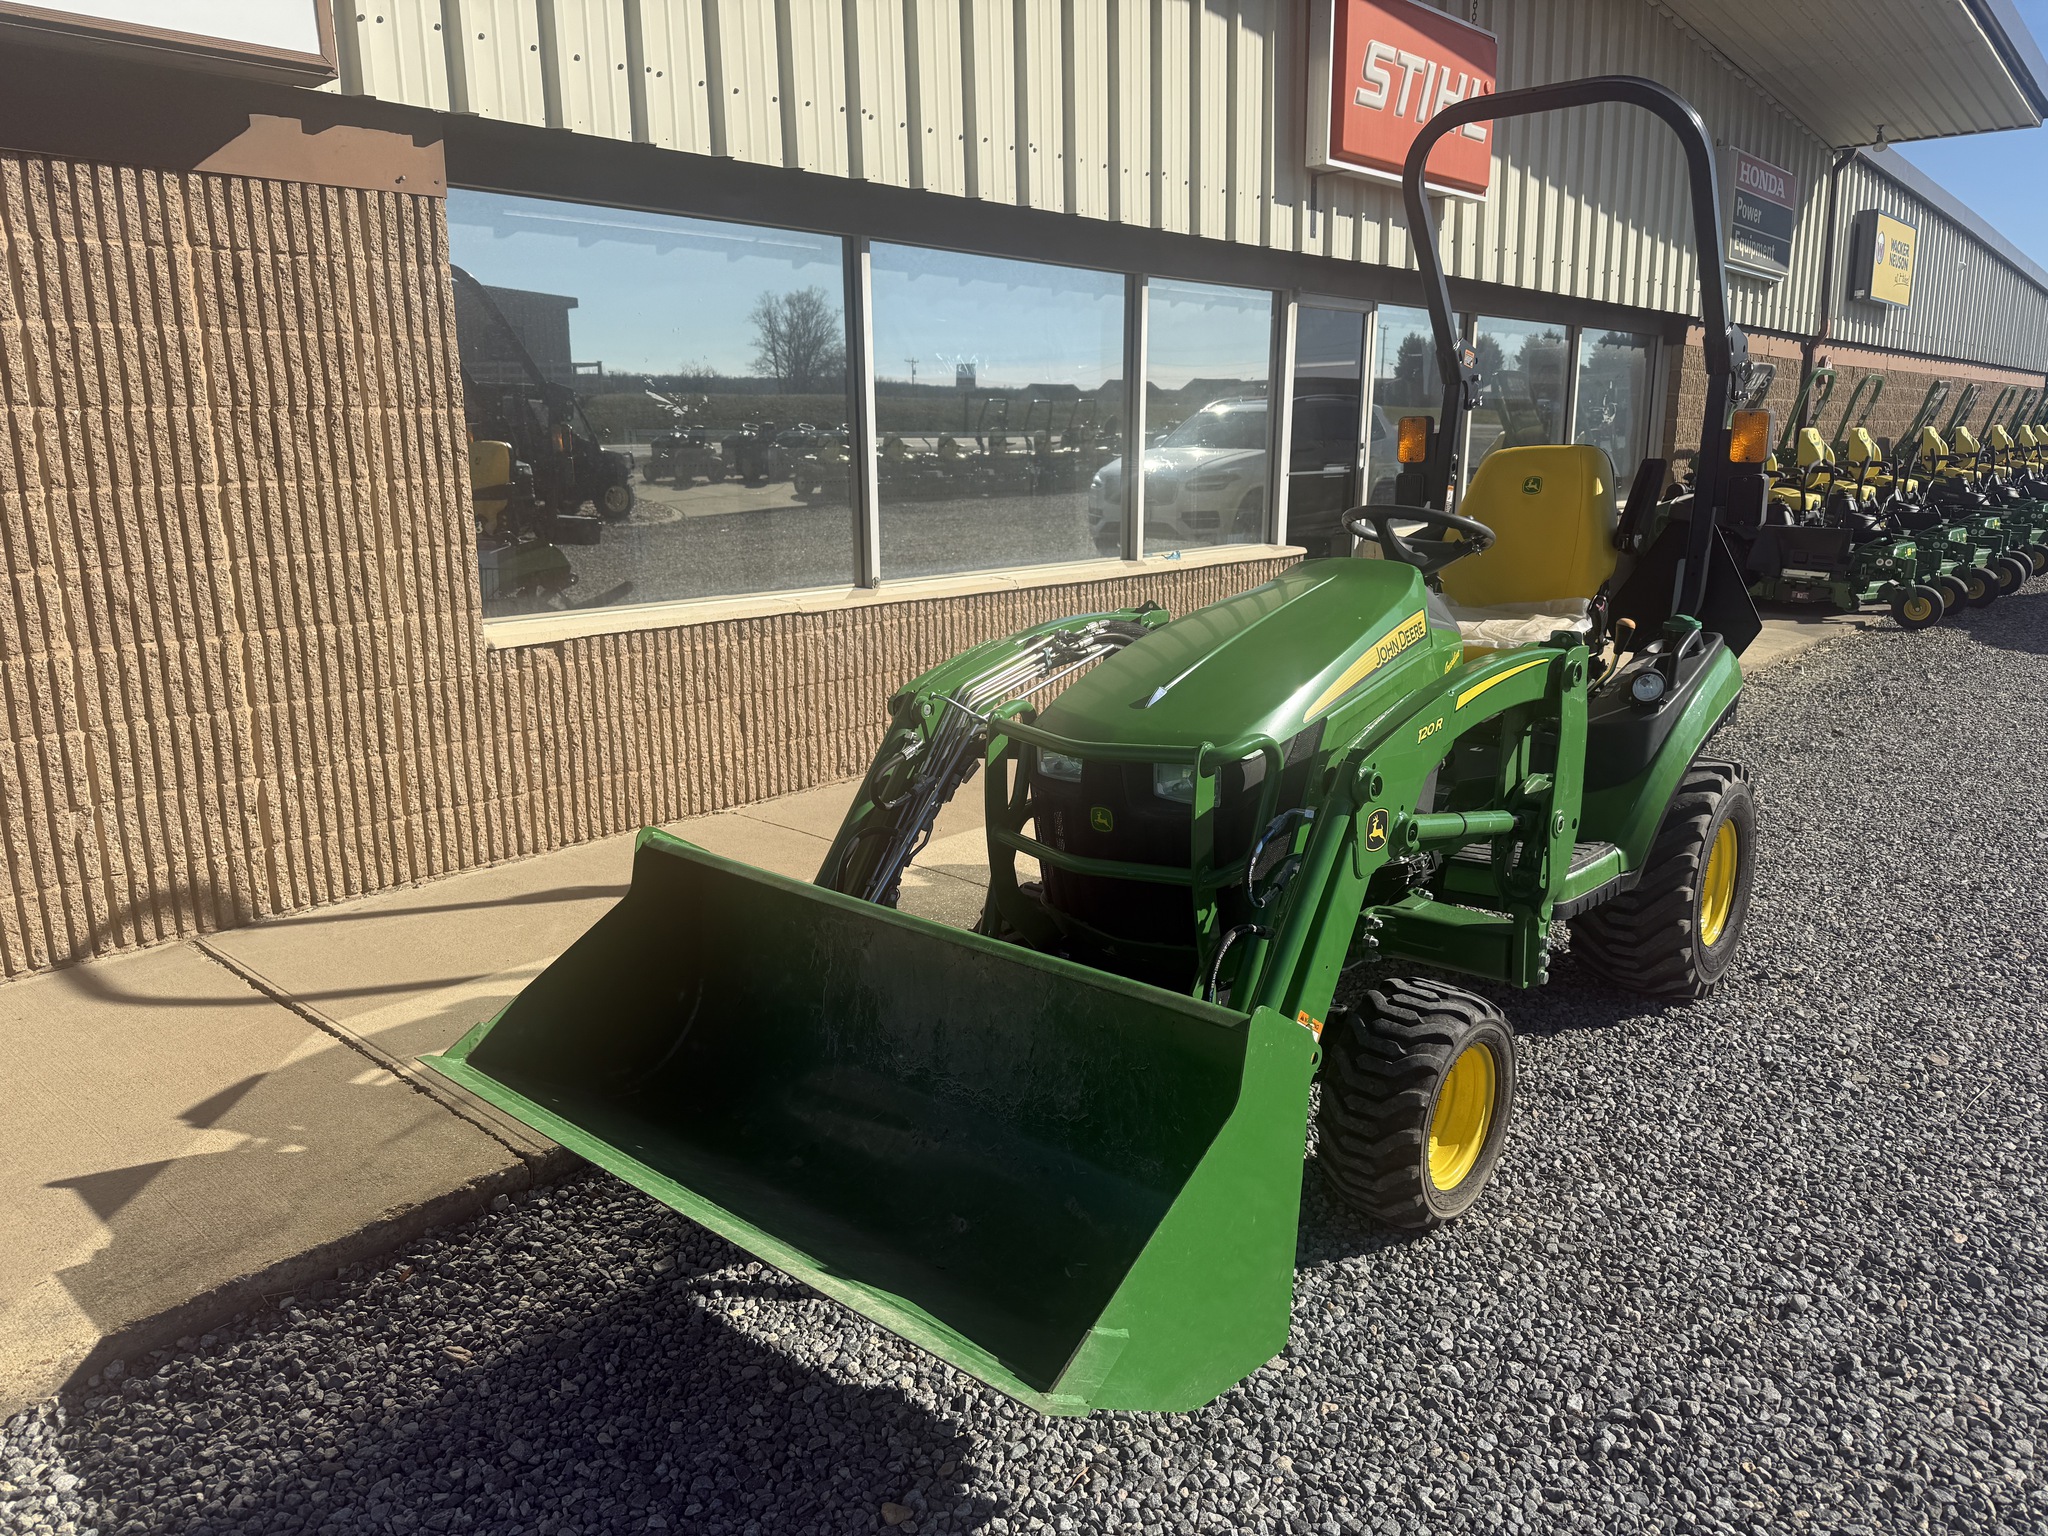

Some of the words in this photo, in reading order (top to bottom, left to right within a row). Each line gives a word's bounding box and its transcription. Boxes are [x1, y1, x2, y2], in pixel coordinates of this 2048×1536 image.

[1353, 39, 1488, 144] STIHL
[1739, 161, 1785, 199] HONDA
[1736, 196, 1761, 223] Power
[1734, 230, 1775, 261] Equipment
[1890, 238, 1910, 258] WACKER
[1889, 252, 1909, 271] NEUSON
[1376, 637, 1400, 666] JOHN
[1398, 621, 1424, 650] DEERE
